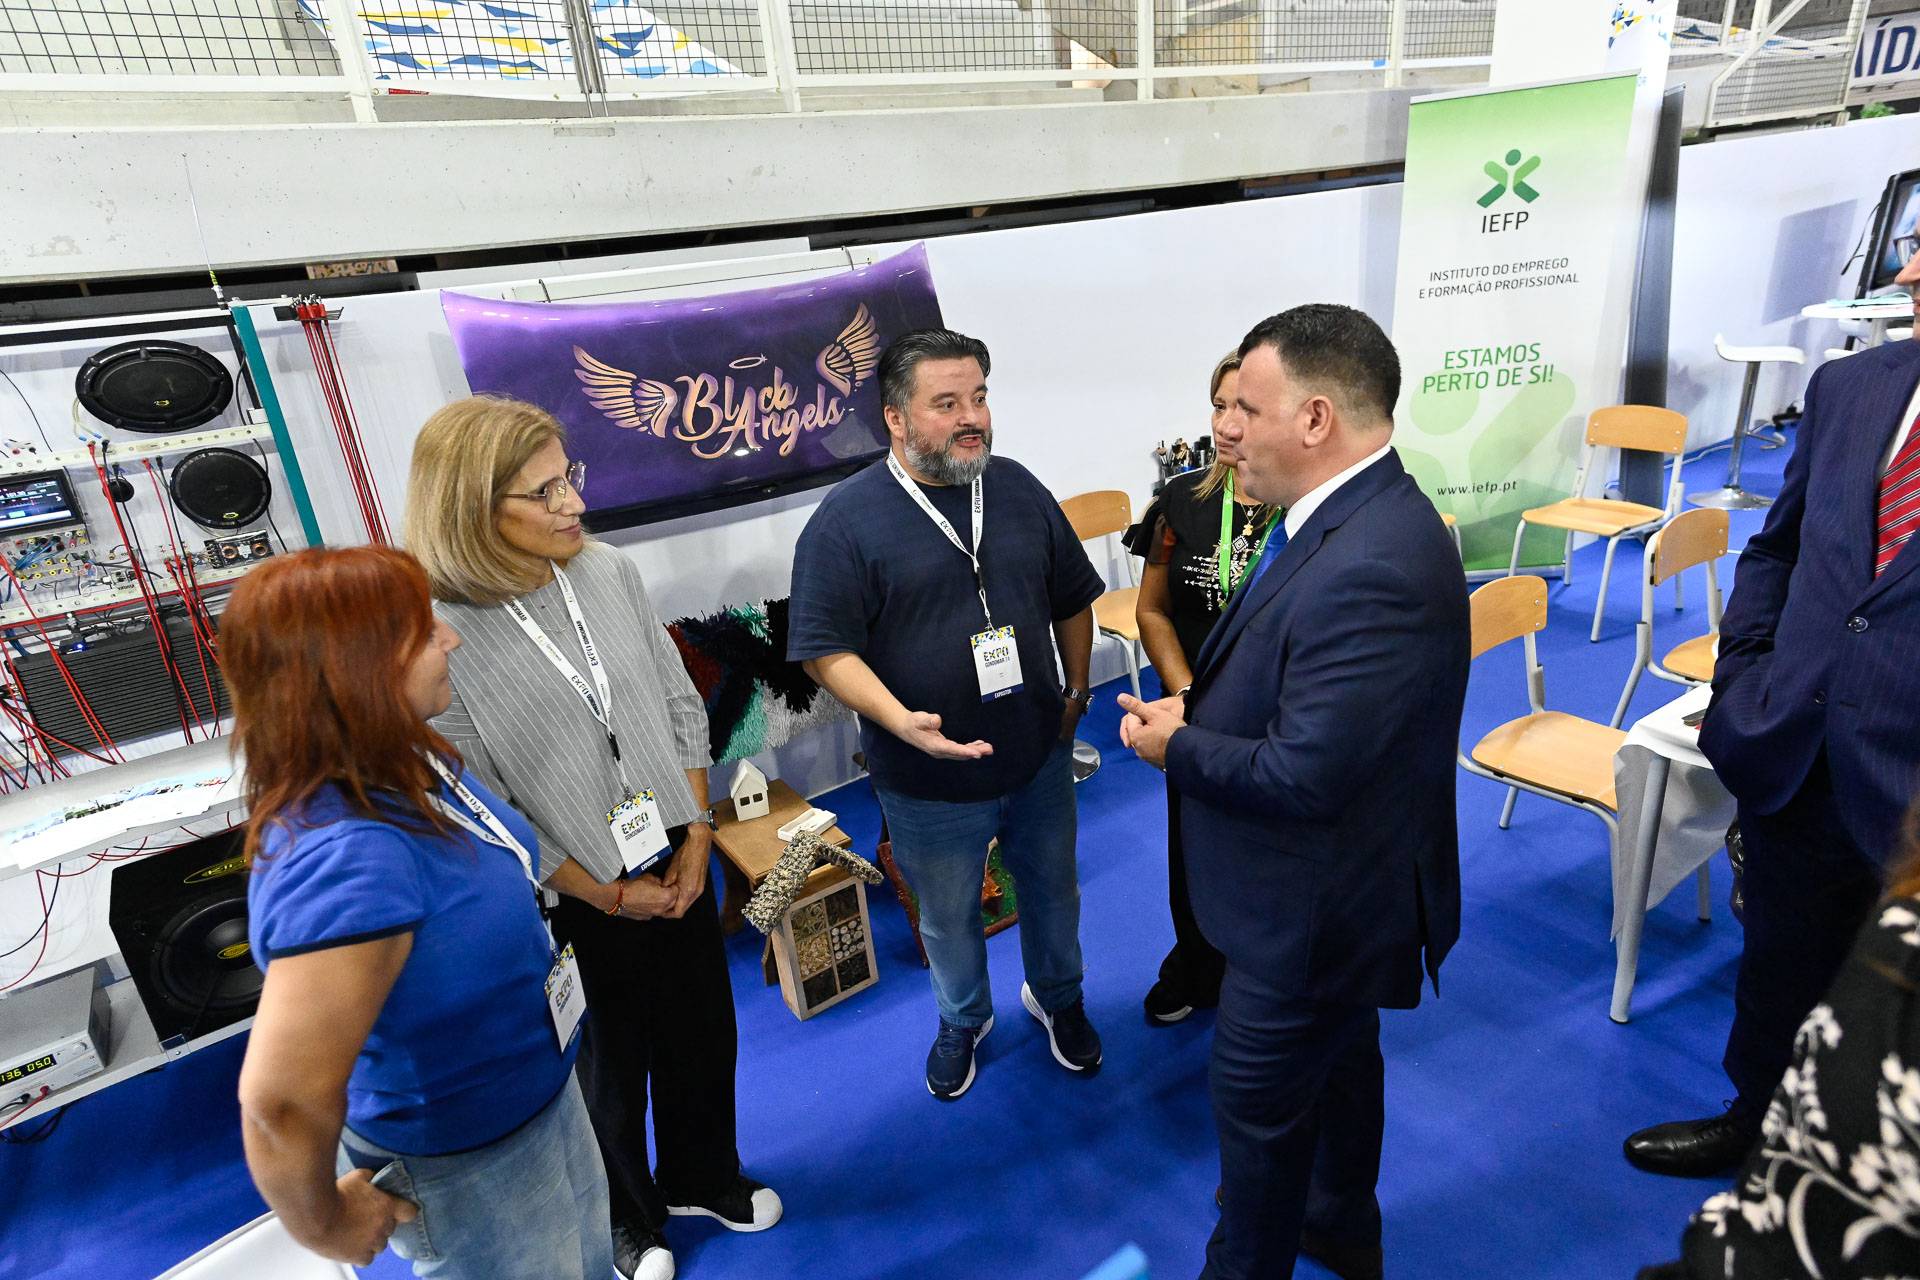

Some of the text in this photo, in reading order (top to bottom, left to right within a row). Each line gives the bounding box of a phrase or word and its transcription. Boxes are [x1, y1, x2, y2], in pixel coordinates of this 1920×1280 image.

[1481, 211, 1529, 234] IEFP
[1429, 257, 1569, 282] INSTITUTO DO EMPREGO
[1419, 273, 1580, 299] E FORMAÇÃO PROFISSIONAL
[1444, 343, 1541, 370] ESTAMOS
[1423, 365, 1554, 394] PERTO DE SI!
[691, 384, 845, 459] Angels
[1437, 479, 1517, 496] www.iefp.pt
[585, 645, 598, 667] EXPO
[983, 645, 1009, 662] EXPO
[571, 675, 589, 695] EXPO
[621, 812, 649, 835] EXPO
[555, 973, 573, 1008] EXPO
